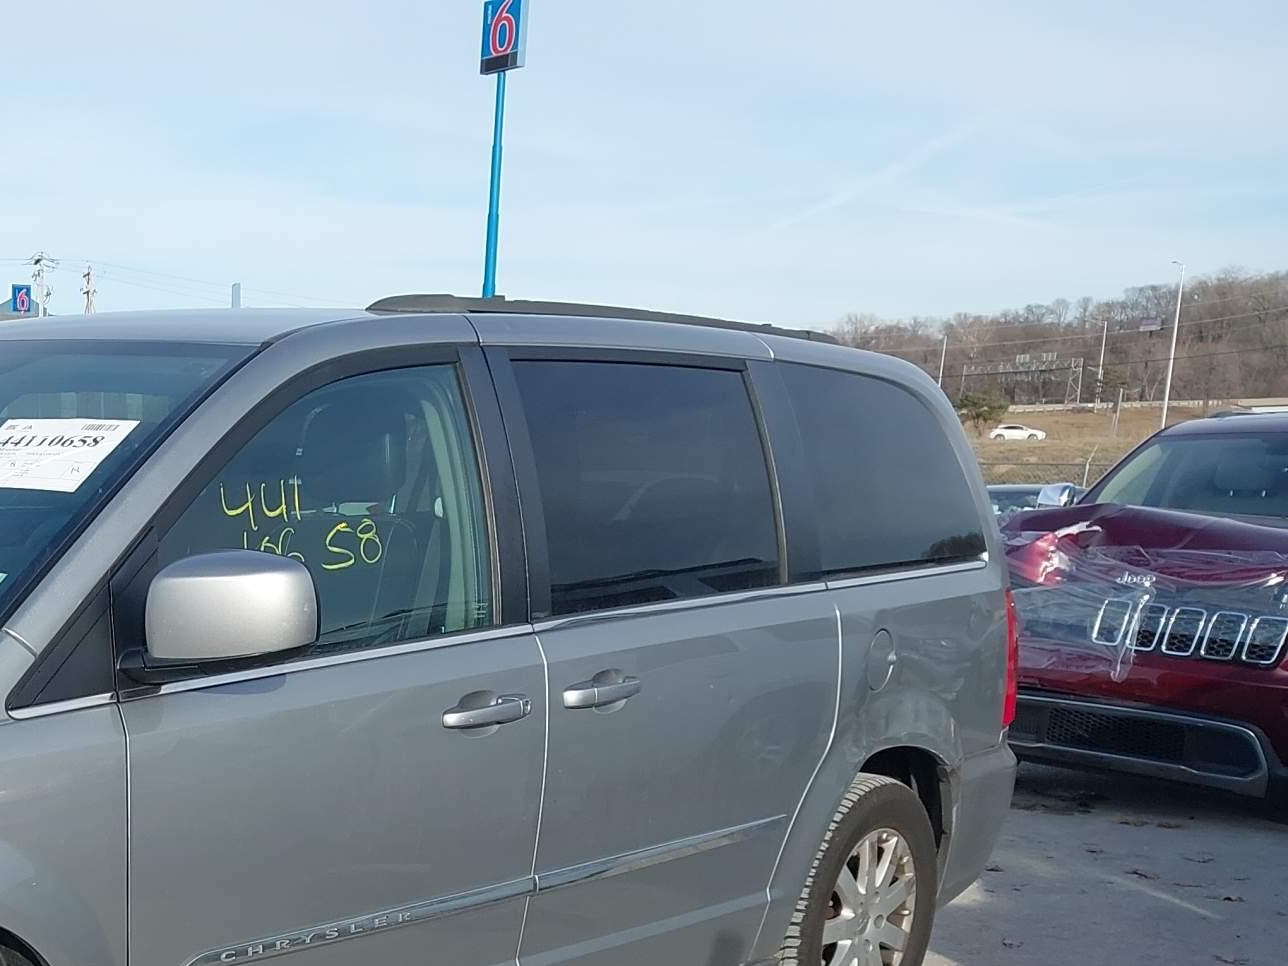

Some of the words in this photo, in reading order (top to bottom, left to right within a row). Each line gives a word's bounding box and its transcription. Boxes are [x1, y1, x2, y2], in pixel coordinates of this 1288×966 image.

[489, 0, 516, 57] 6
[16, 288, 29, 311] 6
[219, 475, 302, 532] 441
[320, 518, 383, 570] 58
[220, 911, 412, 963] CHRYSLER
